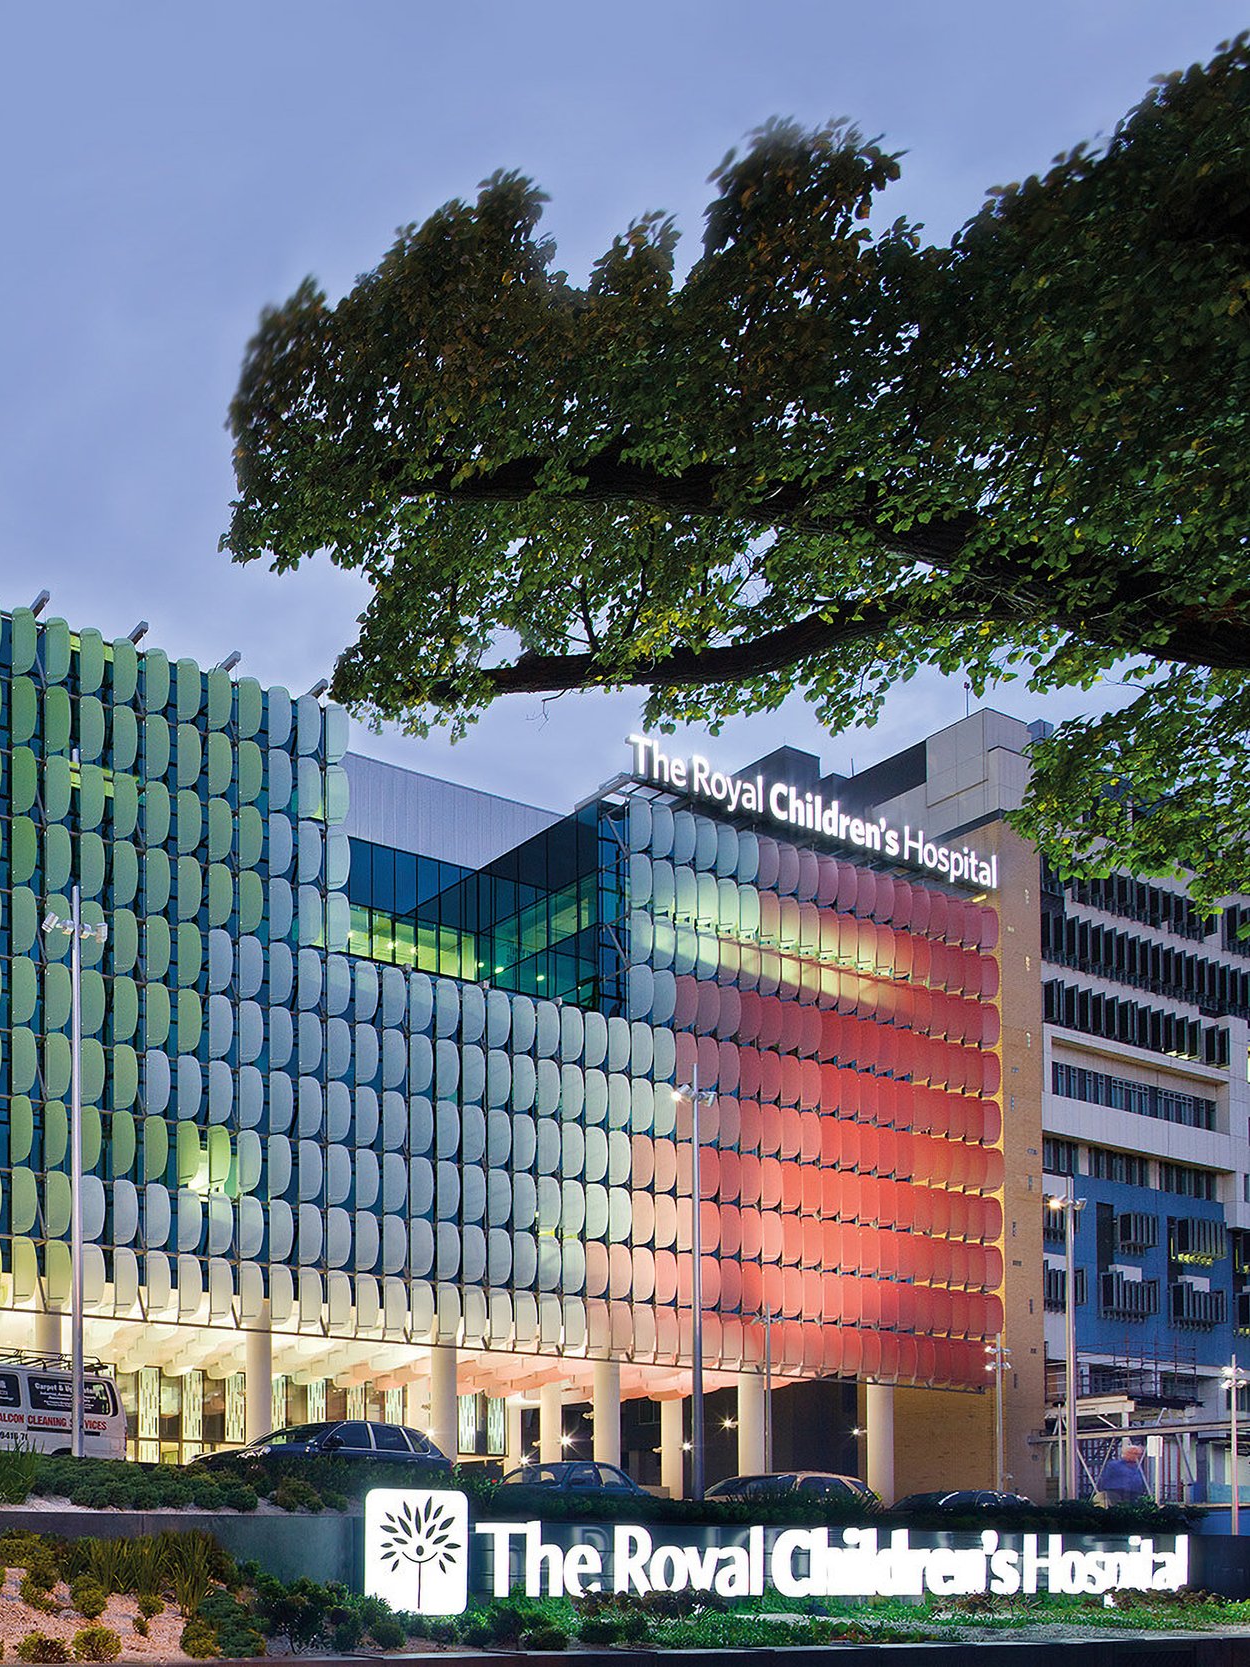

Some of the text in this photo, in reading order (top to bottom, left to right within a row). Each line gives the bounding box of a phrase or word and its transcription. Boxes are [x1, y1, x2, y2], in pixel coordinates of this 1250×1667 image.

[628, 734, 999, 889] The Royal Children's Hospital
[34, 1382, 57, 1392] Carpet
[27, 1414, 67, 1428] CLEANING
[69, 1419, 108, 1431] VICES
[475, 1520, 1190, 1608] The Royal Children's Hospital
